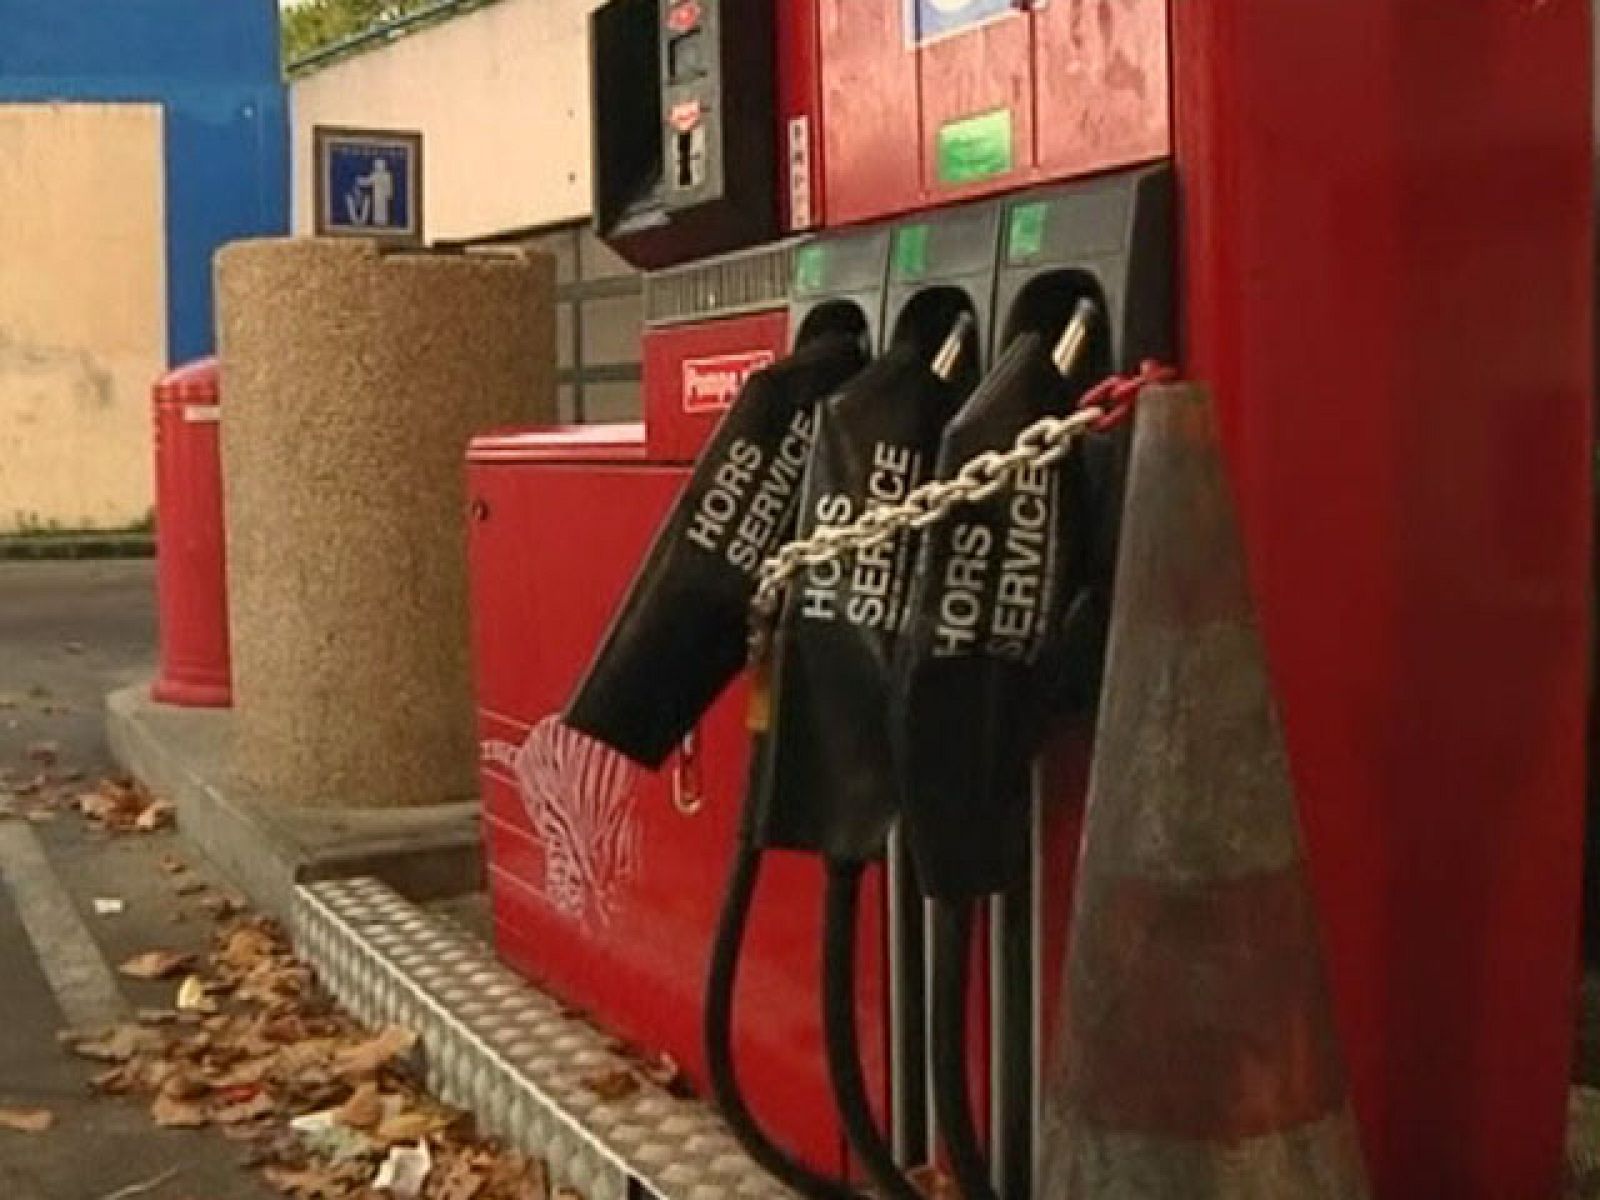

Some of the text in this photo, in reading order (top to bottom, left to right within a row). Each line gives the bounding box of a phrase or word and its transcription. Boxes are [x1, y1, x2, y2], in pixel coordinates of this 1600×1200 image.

[687, 440, 761, 549] HORS
[726, 410, 811, 572] SERVICE
[802, 493, 852, 620] HOS
[932, 523, 992, 658] HORS
